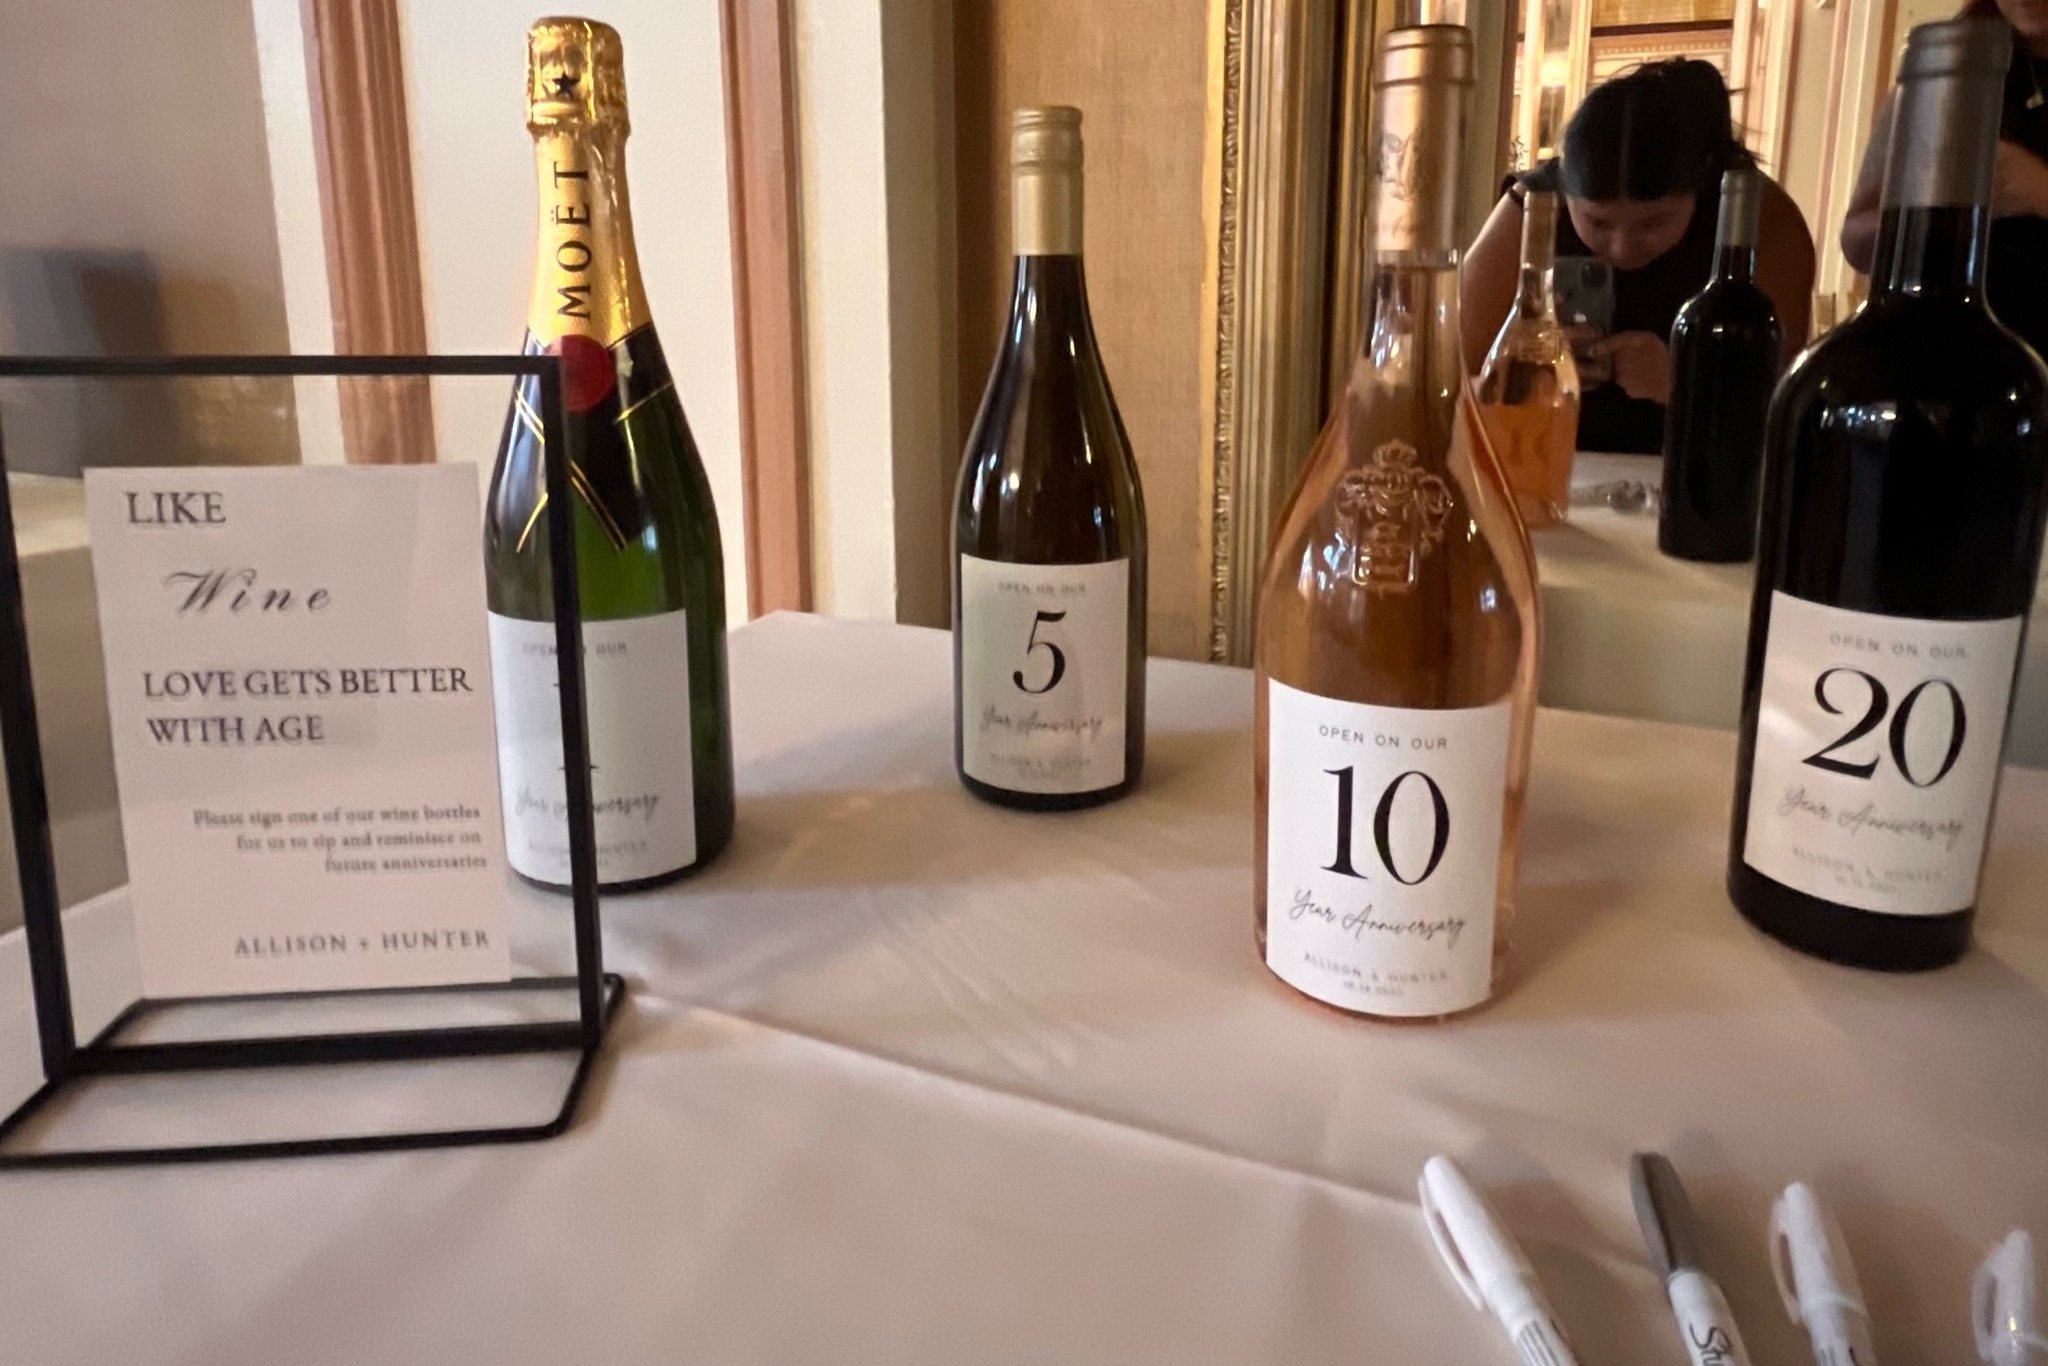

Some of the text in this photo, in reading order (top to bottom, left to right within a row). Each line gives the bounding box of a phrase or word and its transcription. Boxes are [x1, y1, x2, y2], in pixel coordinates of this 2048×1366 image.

[551, 161, 592, 321] MOËT
[125, 491, 227, 526] LIKE
[164, 567, 334, 616] Wine
[1013, 611, 1067, 694] 5
[1829, 632, 1969, 659] OPEN ON OUR
[143, 667, 474, 699] LOVE GETS BETTER
[147, 715, 325, 744] WITH AGE
[1318, 724, 1448, 750] OPEN ON OUR
[1800, 666, 1967, 788] 20
[193, 804, 480, 832] Please sign one of our wine bottles
[1320, 765, 1450, 886] 10
[236, 834, 262, 849] for
[266, 837, 285, 850] us
[290, 836, 308, 849] to
[342, 832, 372, 846] and
[459, 833, 482, 845] on
[325, 854, 377, 872] future
[1289, 887, 1467, 950] Year Anniversary
[234, 929, 490, 957] ALLISON + HUNTER
